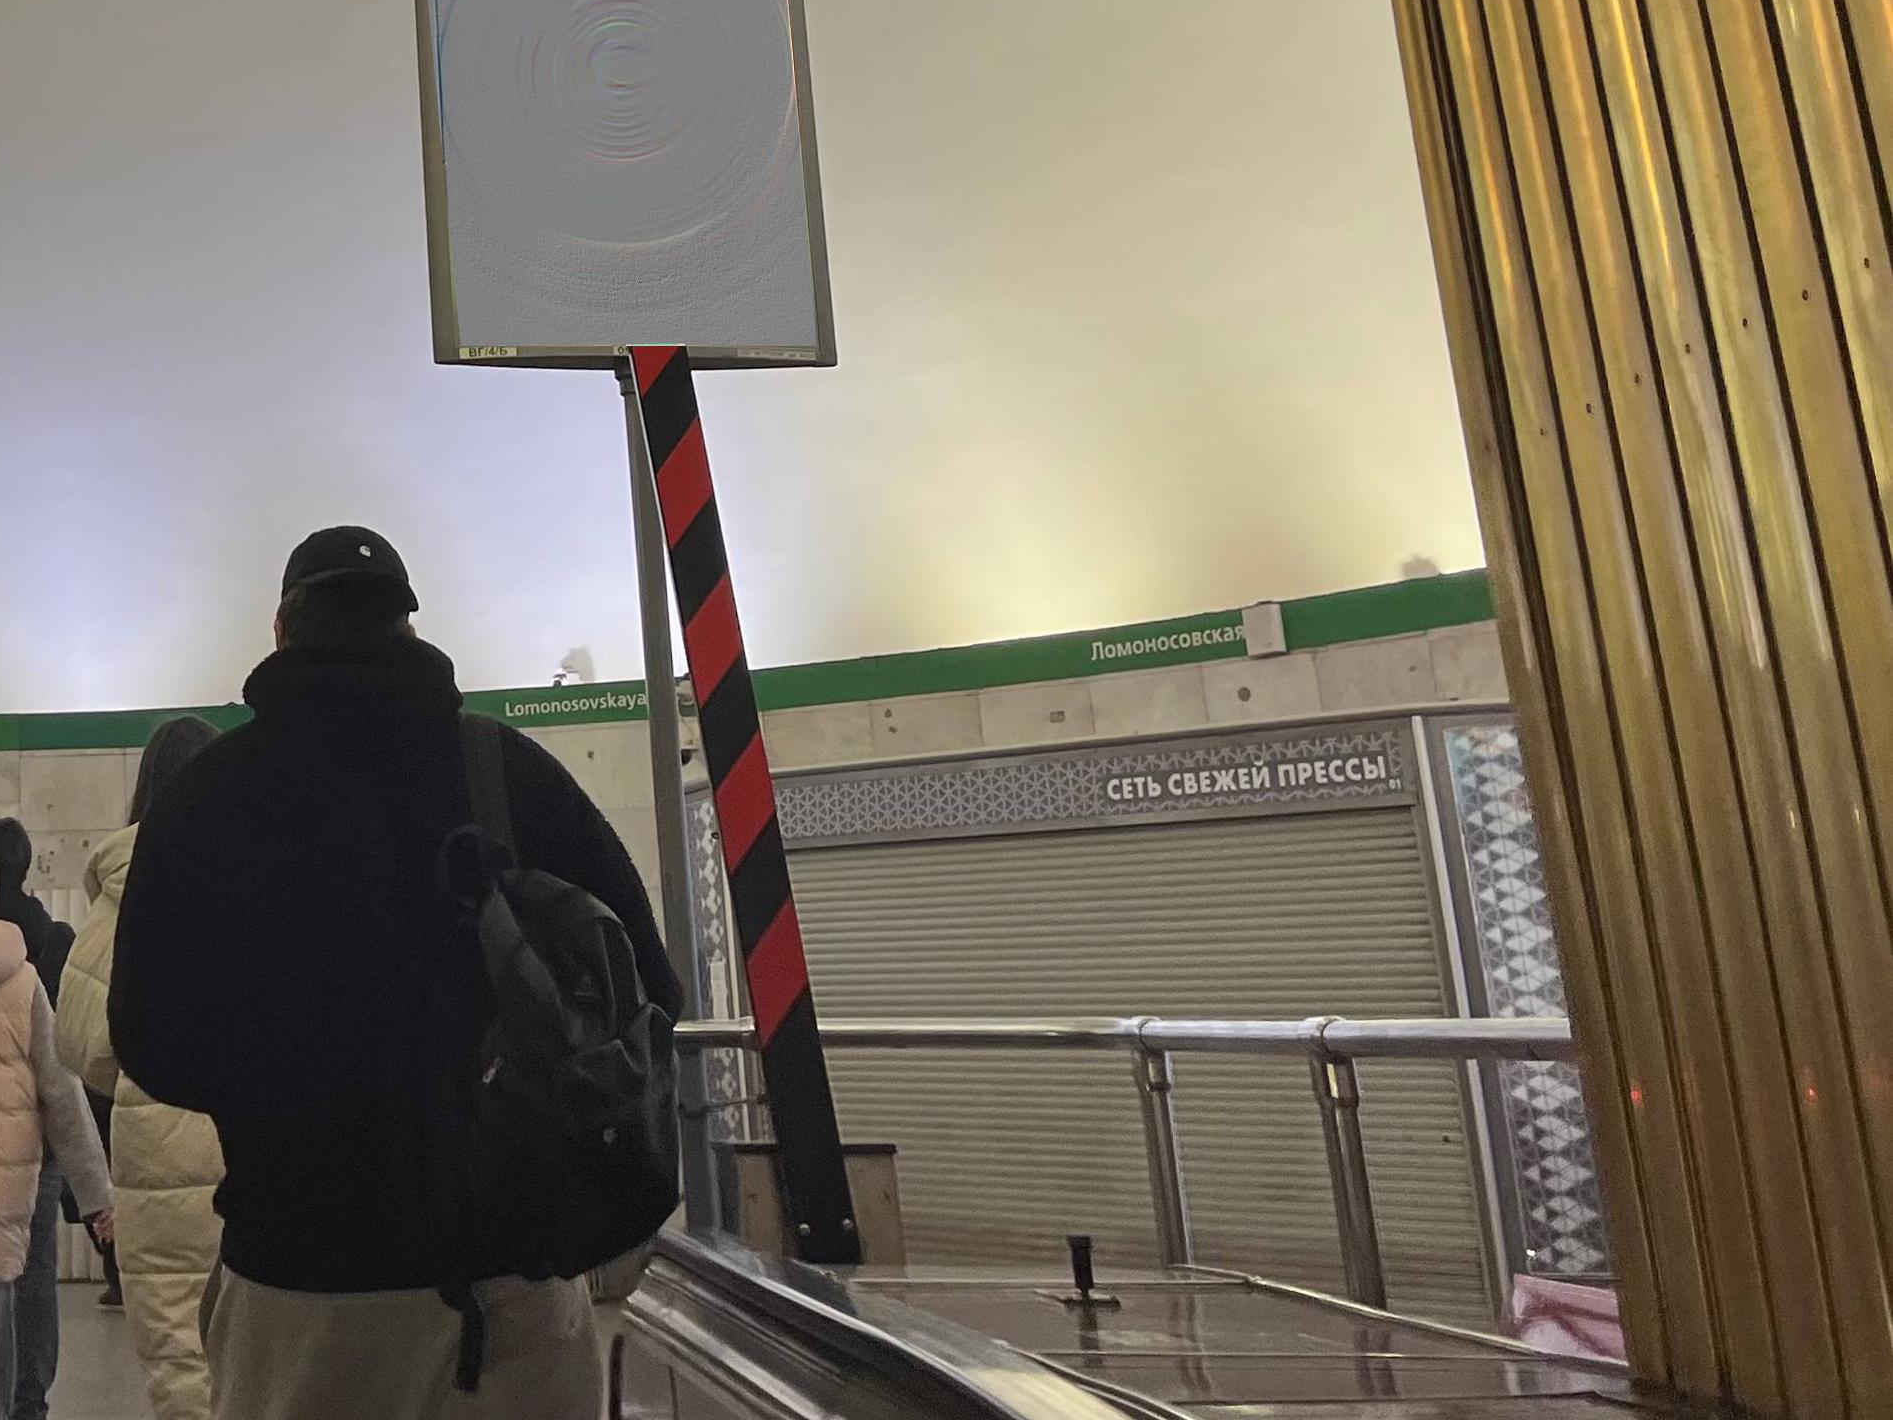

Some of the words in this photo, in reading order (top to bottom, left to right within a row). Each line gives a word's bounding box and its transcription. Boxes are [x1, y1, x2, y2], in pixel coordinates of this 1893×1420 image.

[1091, 625, 1246, 661] Ломоносовская
[505, 692, 647, 717] Lomonosovskaya
[1107, 776, 1162, 801] СЕТЬ
[1167, 759, 1271, 797] СВЕЖЕЙ
[1277, 755, 1386, 786] ПРЕССЫ
